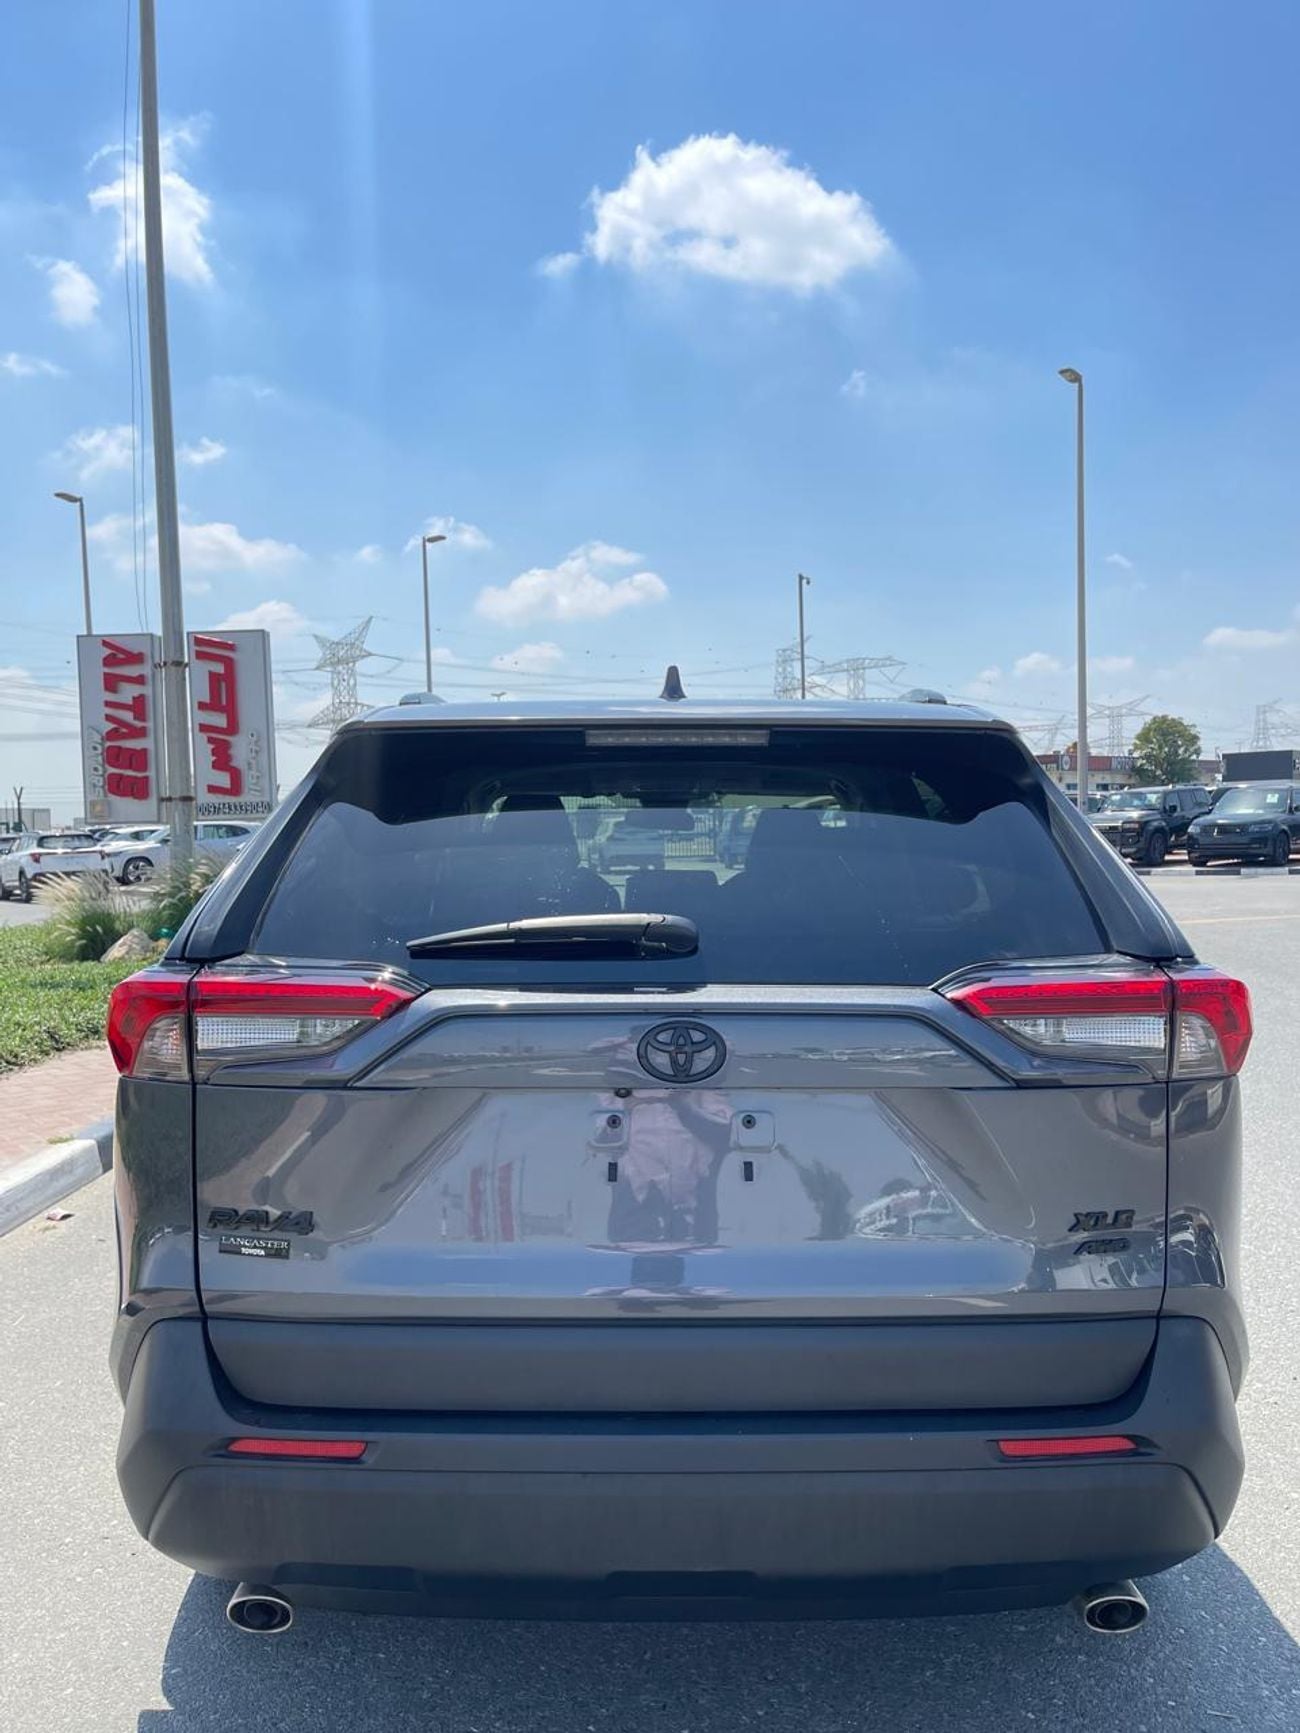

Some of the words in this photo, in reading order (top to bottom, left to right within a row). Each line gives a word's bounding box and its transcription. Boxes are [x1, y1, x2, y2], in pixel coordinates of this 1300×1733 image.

[88, 727, 107, 798] MOTORS
[207, 1206, 315, 1236] RAV4
[1067, 1209, 1135, 1232] XLE
[221, 1236, 289, 1249] LANCASTER
[240, 1247, 266, 1257] TOYOTA
